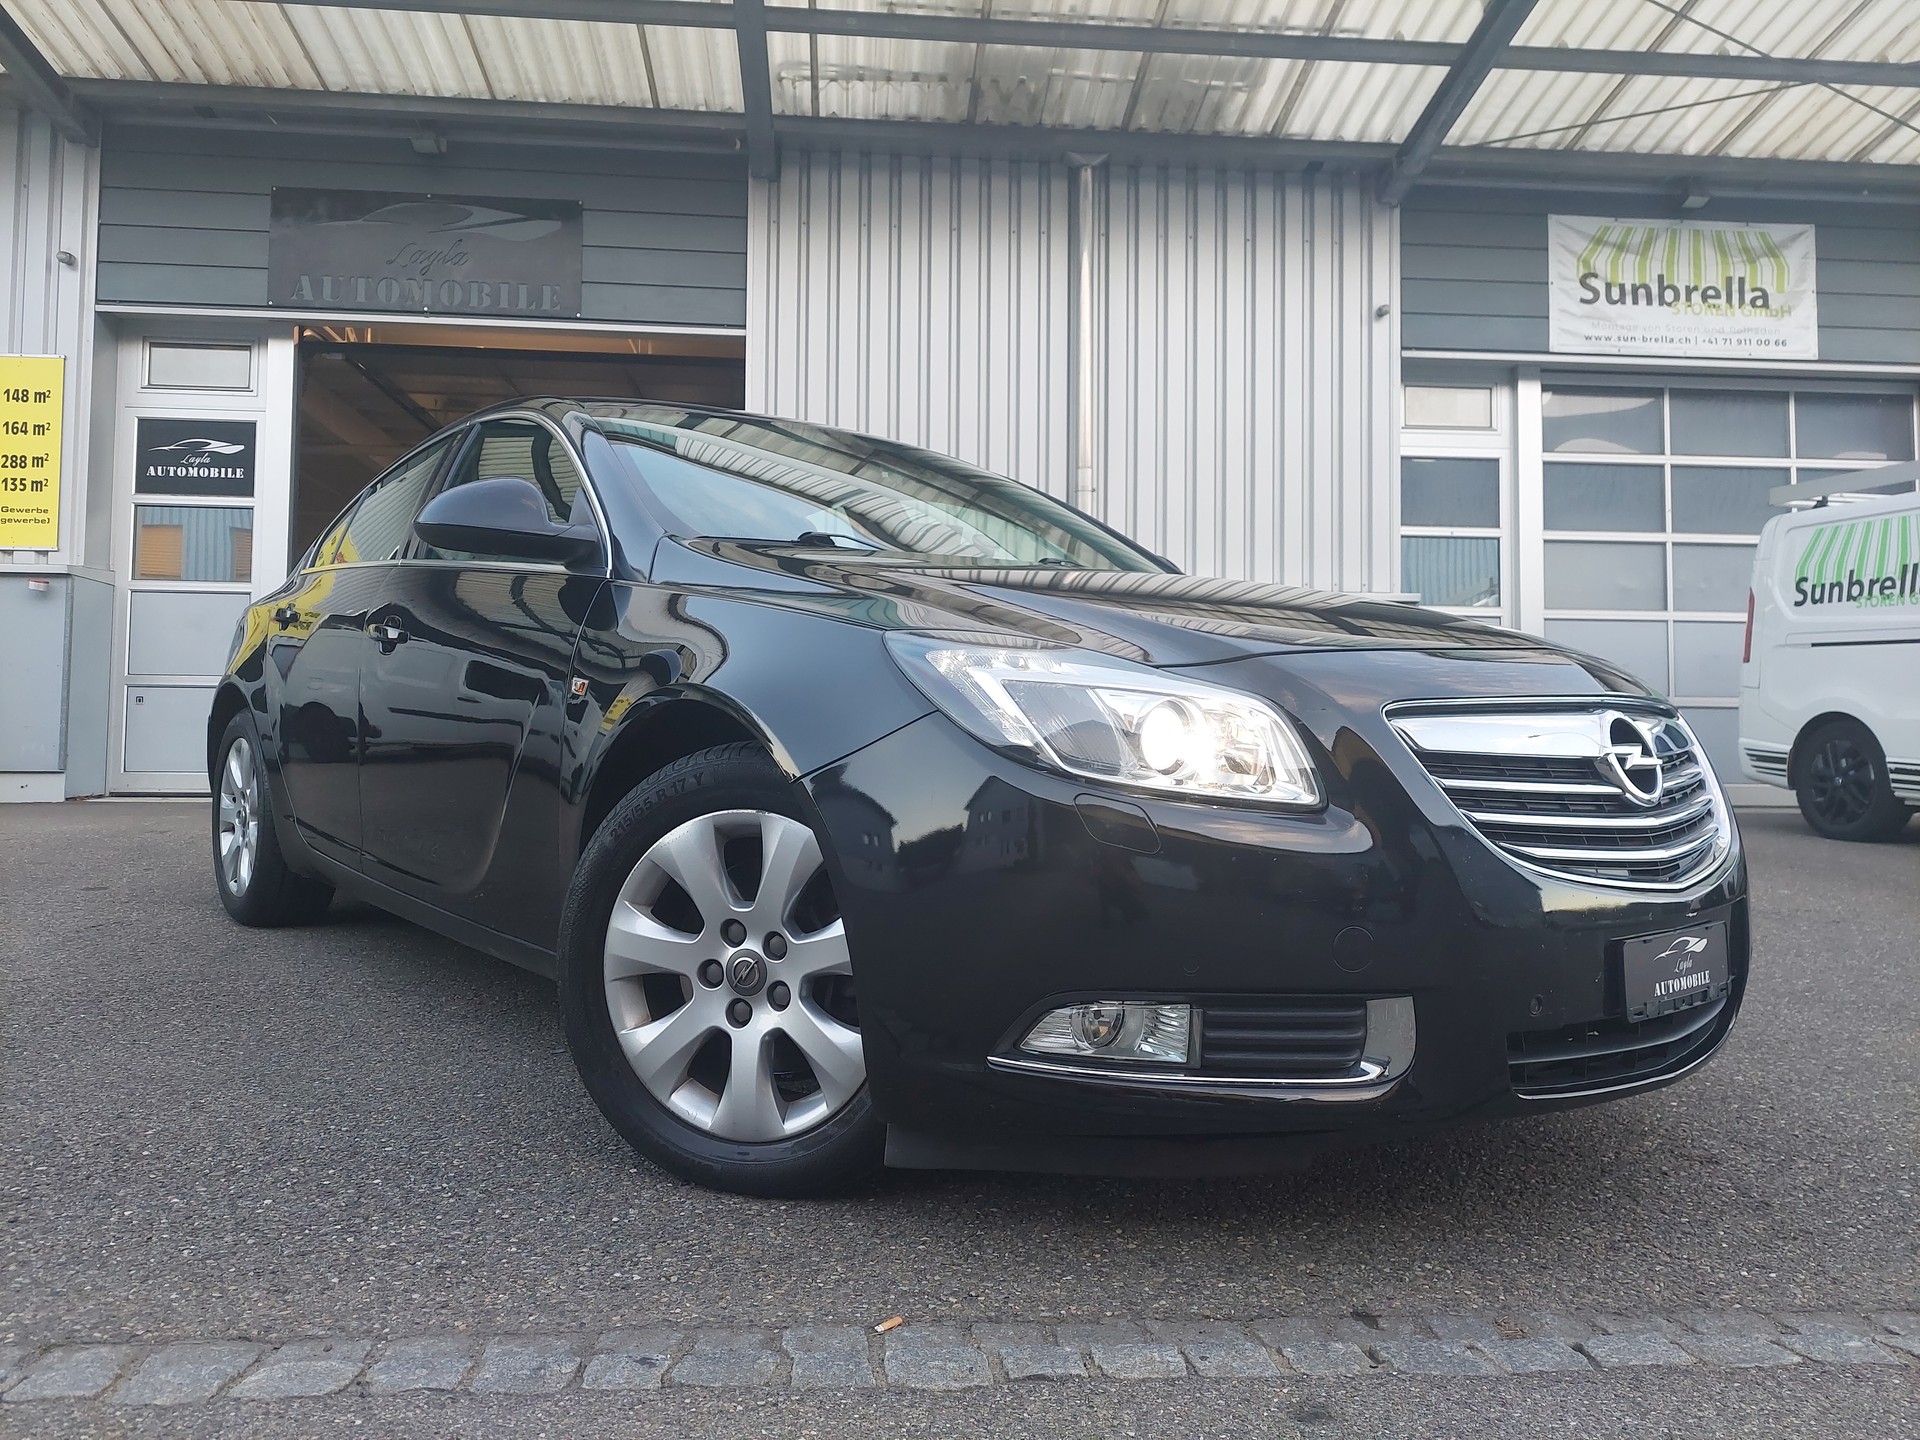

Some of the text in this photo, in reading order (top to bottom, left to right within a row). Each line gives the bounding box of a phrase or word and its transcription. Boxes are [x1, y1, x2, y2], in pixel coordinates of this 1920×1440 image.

[386, 239, 469, 276] Layla
[290, 274, 562, 311] AUTOMOBILE
[1579, 271, 1770, 309] Sunbrella
[1671, 301, 1793, 319] STOREN GmbH
[1584, 334, 1691, 345] www.sun-brella.ch
[3, 388, 30, 403] 148
[2, 421, 29, 436] 164
[0, 454, 28, 469] 288
[180, 452, 211, 466] Layla
[146, 465, 245, 479] AUTOMOBILE
[1, 477, 27, 492] 135
[1, 505, 49, 514] Gewerbe
[1794, 563, 1920, 607] Sunbrell
[1855, 593, 1906, 608] STOREN
[671, 778, 687, 794] 17
[1654, 970, 1711, 997] AUTOMOBILE
